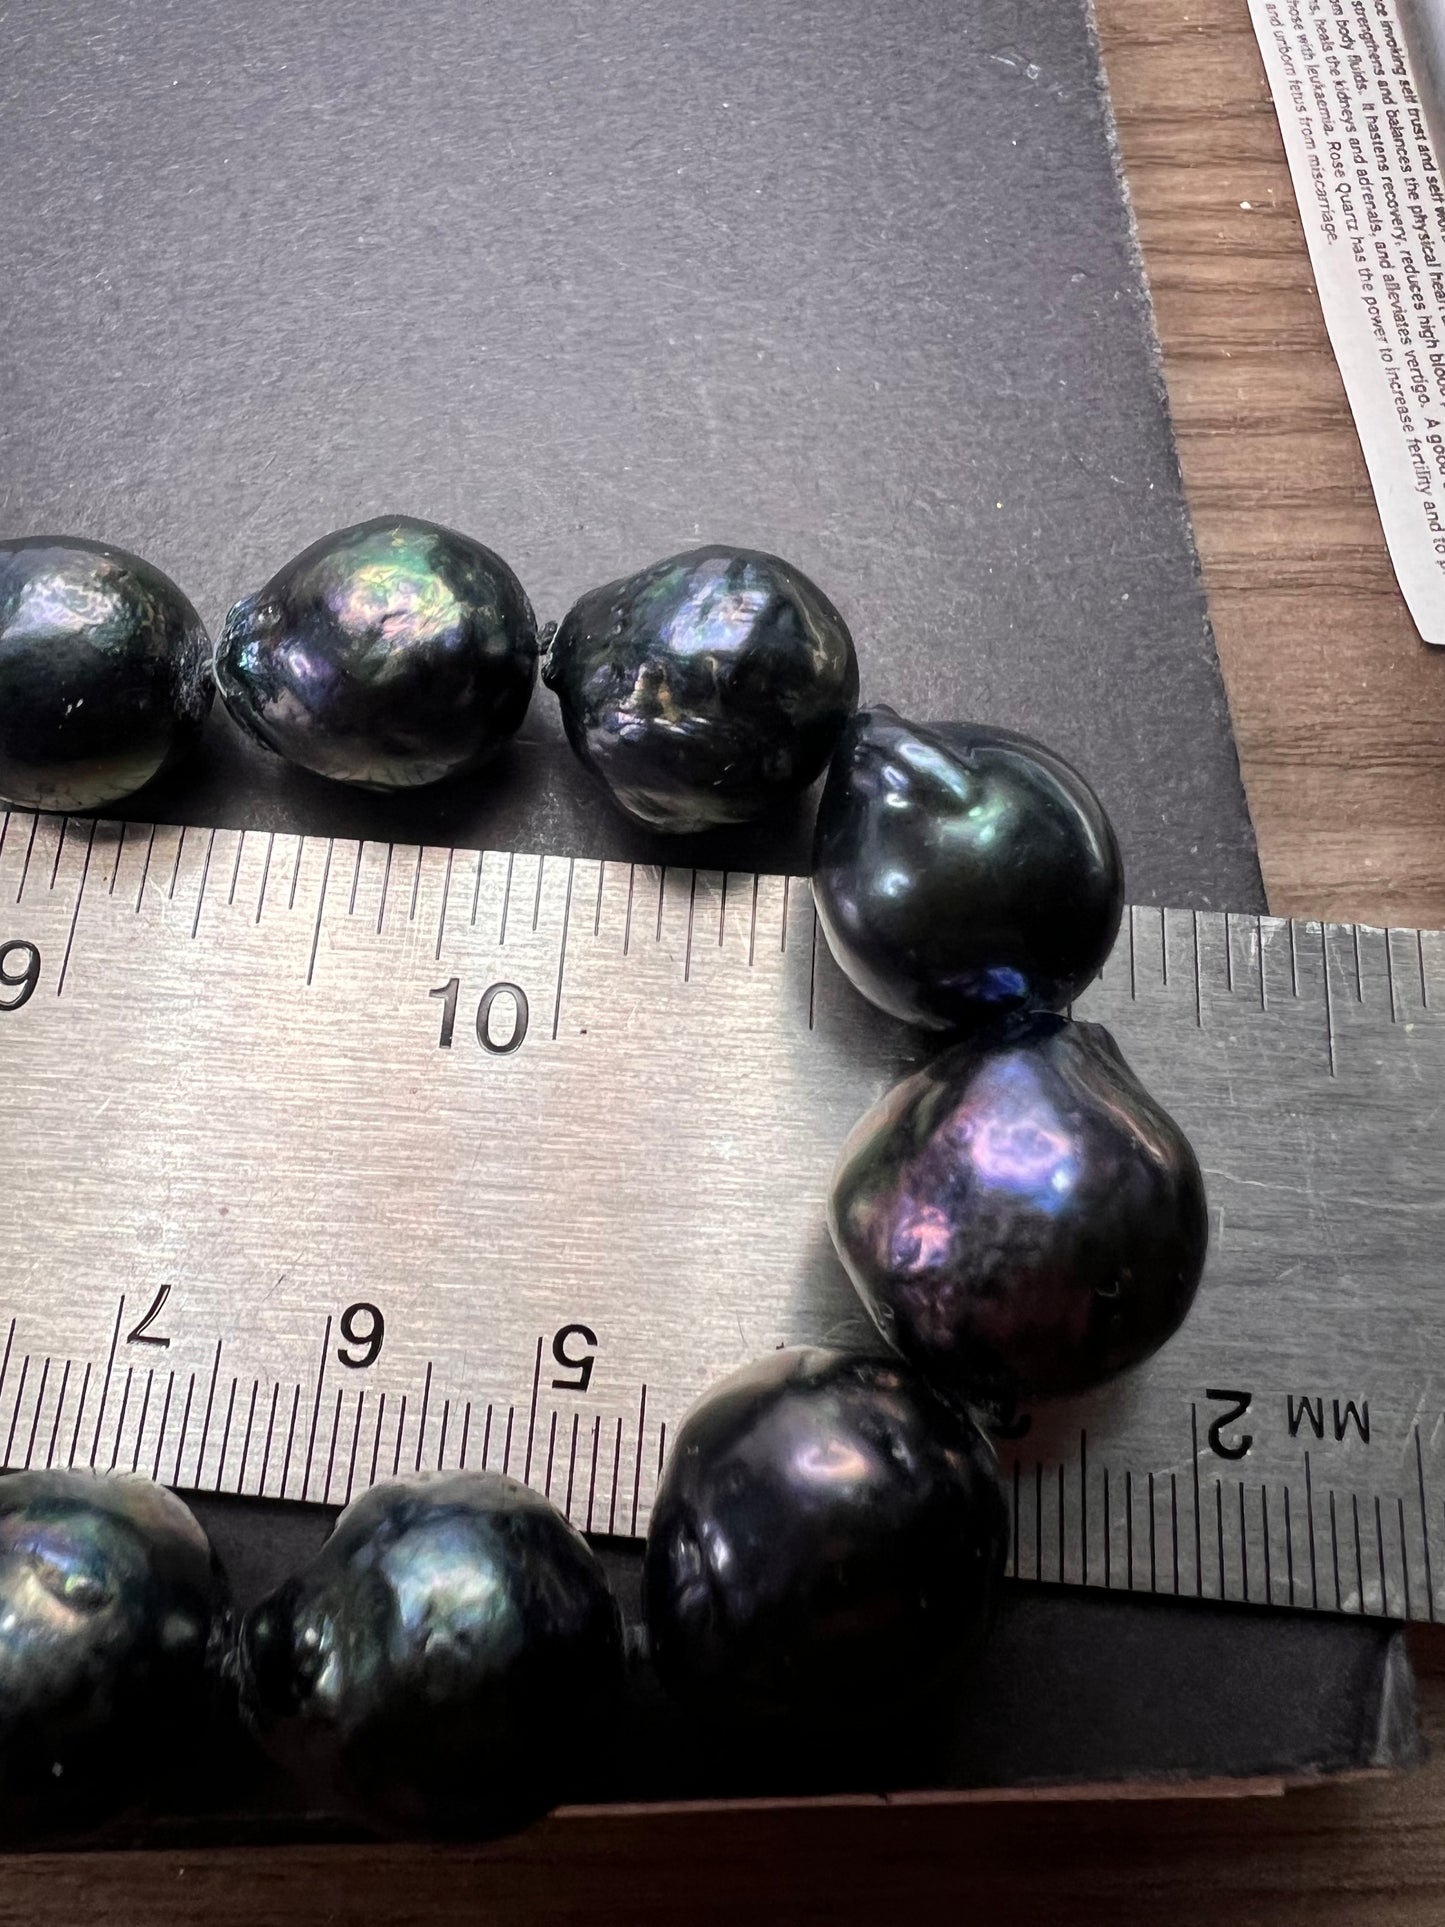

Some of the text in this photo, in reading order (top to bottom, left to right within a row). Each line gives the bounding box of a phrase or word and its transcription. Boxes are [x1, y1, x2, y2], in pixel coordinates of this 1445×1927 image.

[1297, 34, 1316, 61] with
[1313, 19, 1335, 52] heals
[1351, 0, 1385, 76] strengthens
[1380, 20, 1407, 76] invoking
[1325, 55, 1341, 76] the
[1333, 80, 1357, 133] kidneys
[1377, 80, 1398, 105] and
[1399, 78, 1419, 105] self
[1265, 4, 1338, 245] and unborn fetus from miscarriage.
[1386, 109, 1412, 173] balances
[1407, 107, 1427, 141] trust
[1326, 141, 1346, 178] Rose
[1348, 137, 1368, 164] and
[1417, 142, 1437, 173] and
[1335, 19, 1356, 51] body
[1347, 55, 1369, 95] fluids.
[1364, 115, 1390, 172] hastens
[1381, 176, 1407, 246] recovery,
[1399, 250, 1426, 311] reduces
[1417, 315, 1440, 349] high
[1335, 182, 1359, 232] Quartz
[1356, 169, 1383, 237] adrenals,
[1404, 177, 1420, 201] the
[1426, 174, 1445, 203] self
[1350, 236, 1366, 263] has
[1374, 241, 1396, 269] and
[1406, 205, 1442, 268] physical
[1358, 268, 1374, 291] the
[1361, 296, 1388, 344] power
[1382, 274, 1412, 345] alleviates
[1379, 348, 1393, 363] to
[1404, 350, 1430, 408] vertigo.
[1385, 367, 1415, 432] increase
[1424, 417, 1441, 430] A
[1406, 437, 1432, 496] fertility
[1423, 501, 1445, 532] and
[0, 940, 40, 1011] 9
[429, 978, 528, 1055] 10
[127, 1285, 171, 1348] 7
[337, 1302, 384, 1368] 6
[552, 1324, 597, 1392] 5
[1206, 1389, 1252, 1459] 2
[1287, 1395, 1369, 1444] MM
